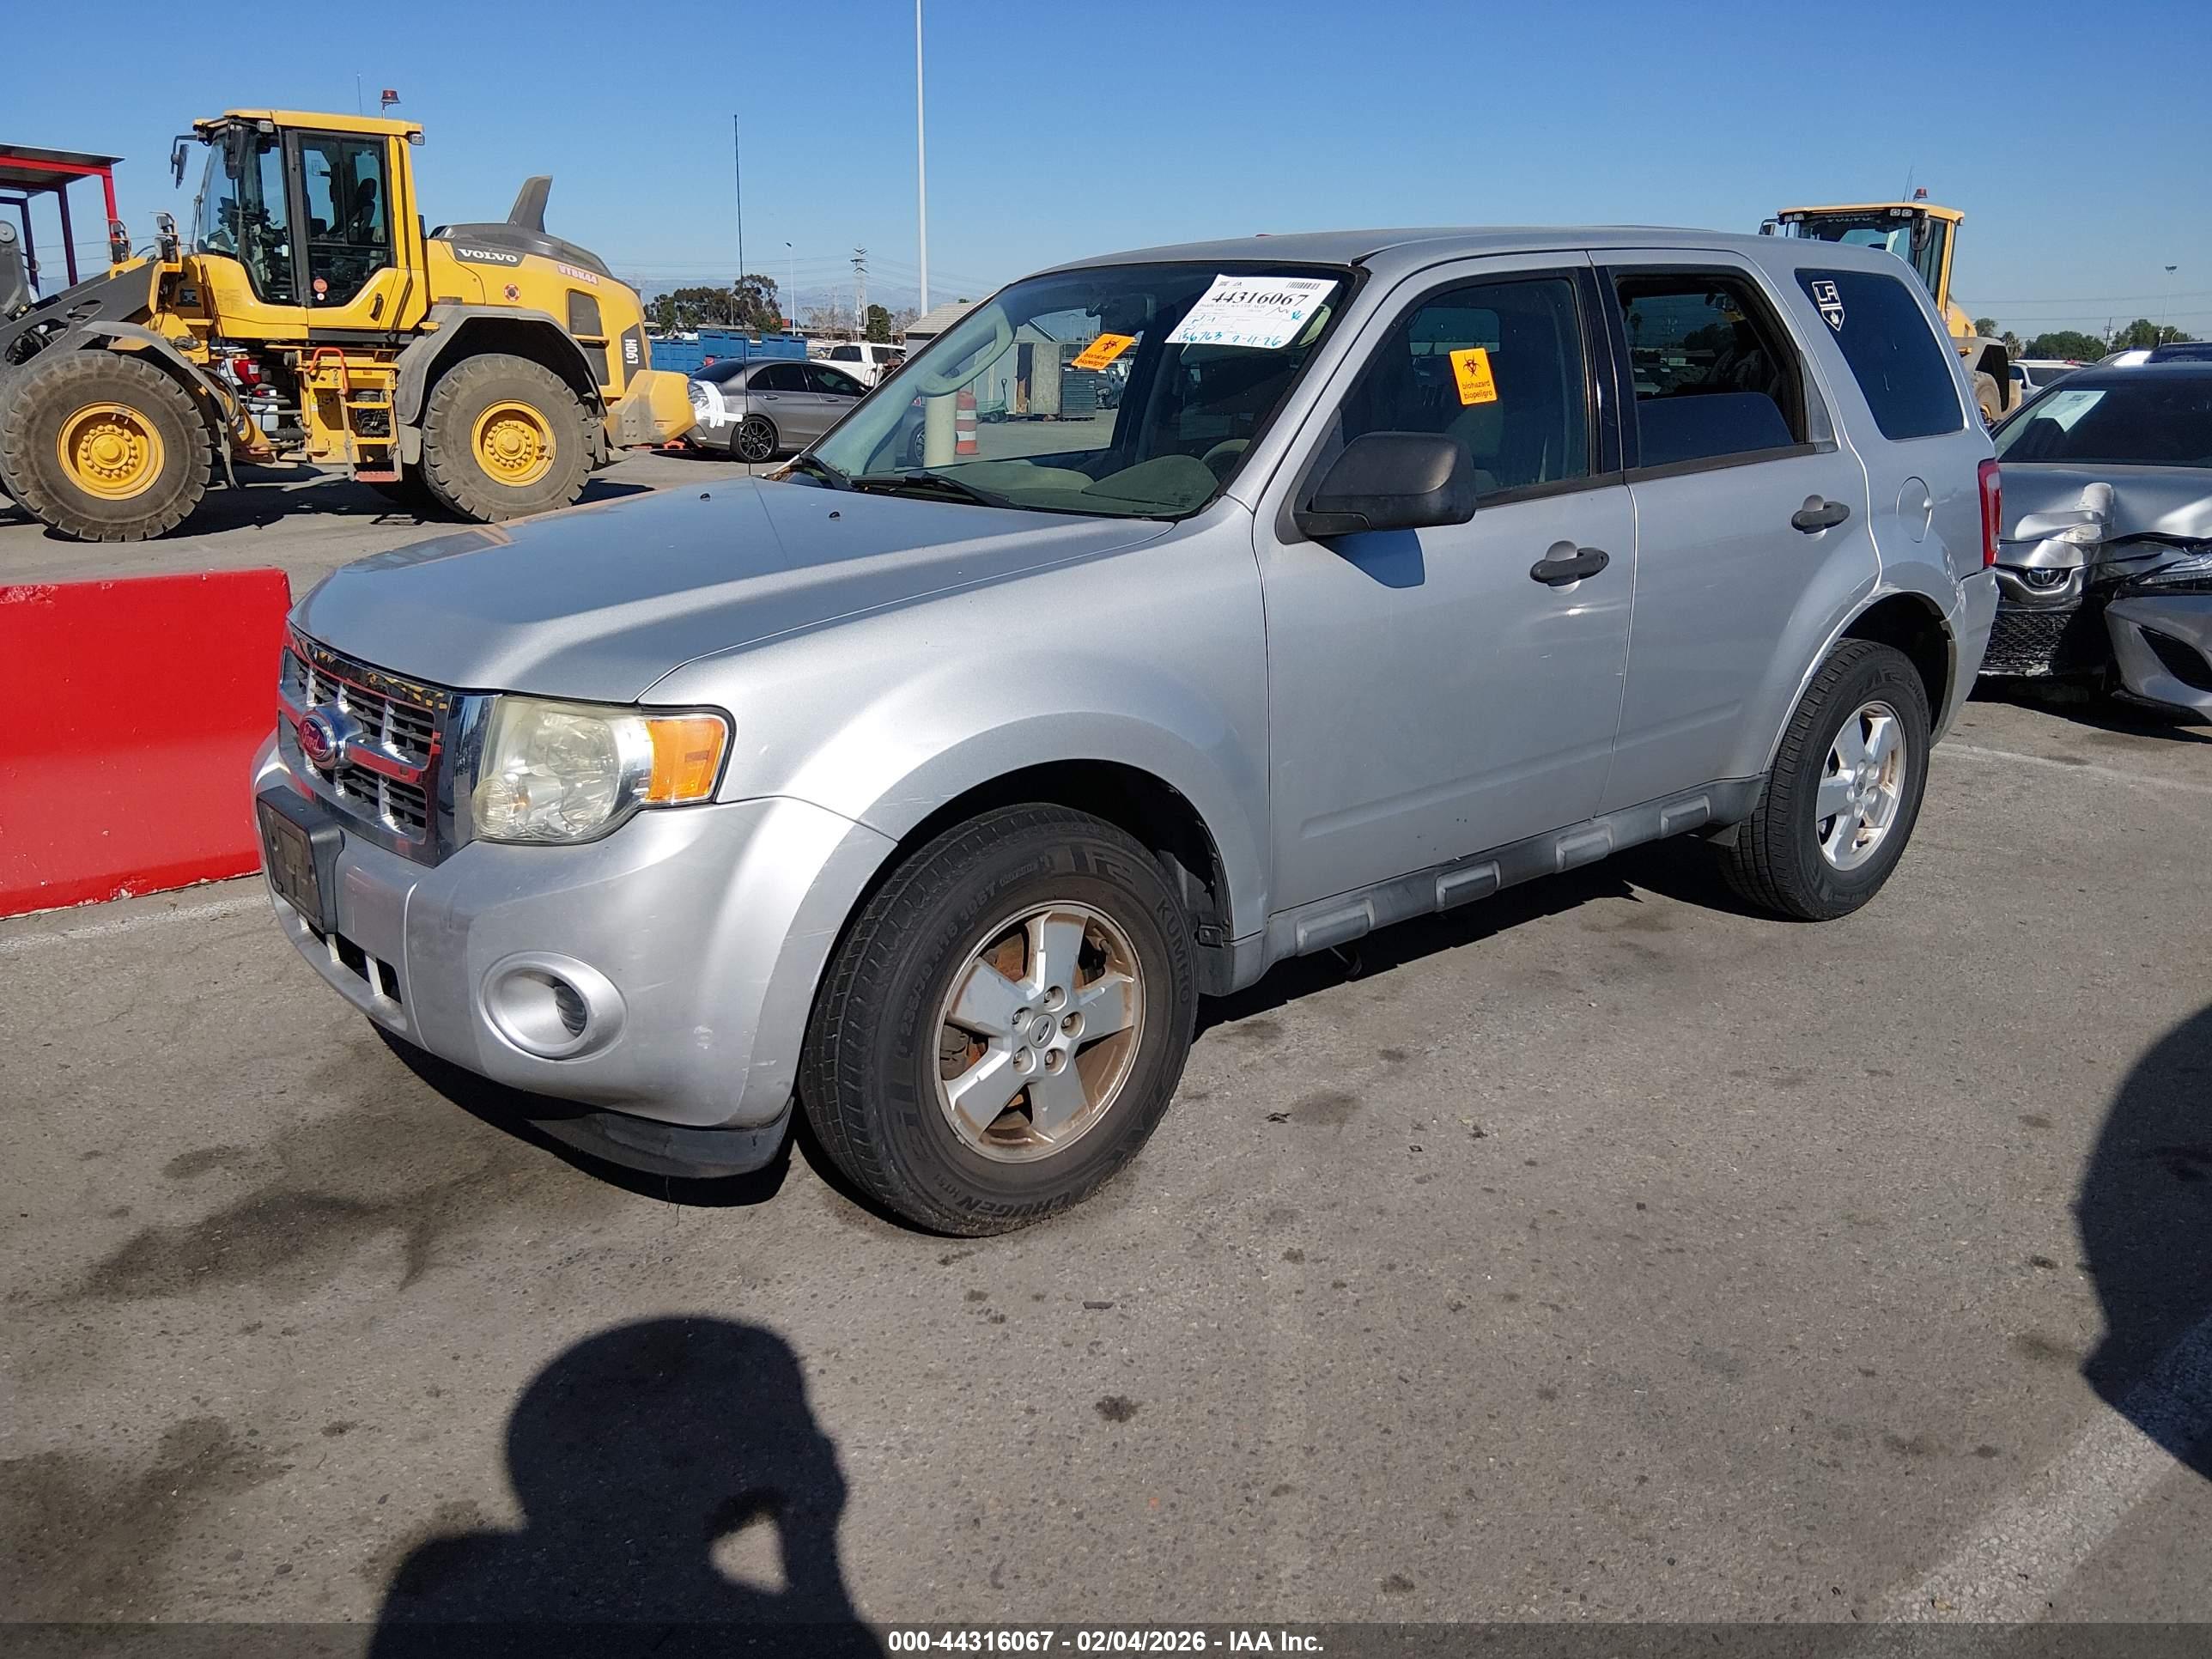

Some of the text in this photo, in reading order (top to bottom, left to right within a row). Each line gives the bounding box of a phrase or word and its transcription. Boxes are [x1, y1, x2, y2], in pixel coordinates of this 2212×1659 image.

[458, 248, 518, 263] VOLVO
[1212, 291, 1310, 307] 44316067
[1814, 285, 1838, 301] LA
[624, 338, 639, 364] L90H
[1462, 380, 1491, 390] biohazard
[1463, 390, 1492, 399] biopeligro
[301, 721, 326, 757] Ford
[1156, 896, 1190, 1003] KUMHO
